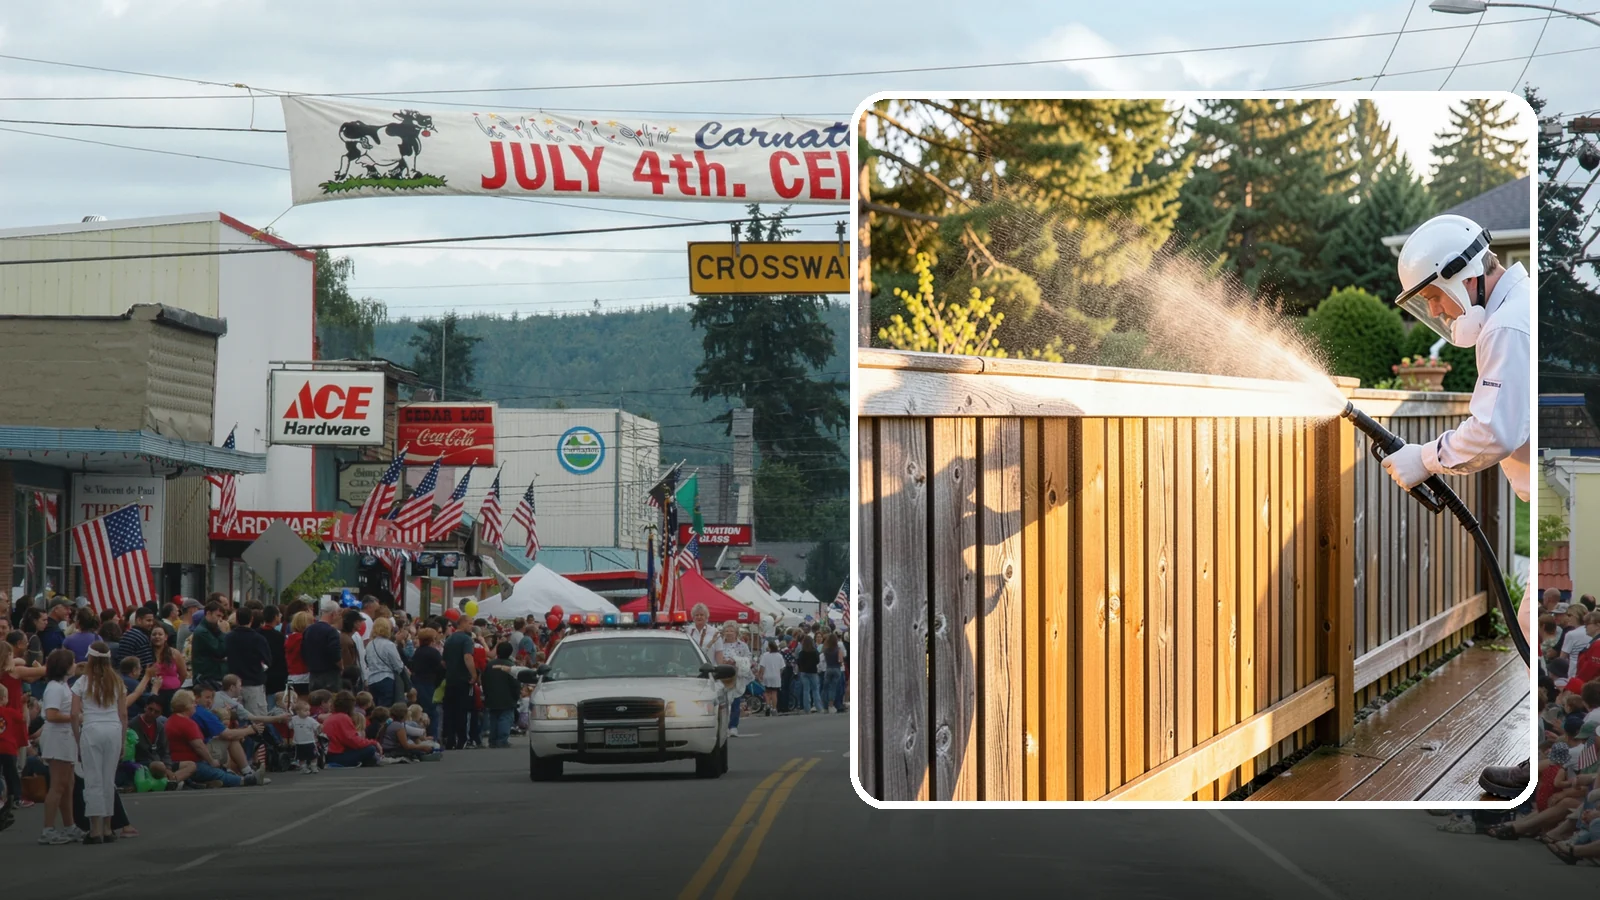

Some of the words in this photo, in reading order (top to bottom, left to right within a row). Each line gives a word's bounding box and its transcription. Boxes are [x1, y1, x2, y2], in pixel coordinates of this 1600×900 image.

[481, 141, 605, 192] JULY
[632, 150, 746, 197] 4th.
[697, 254, 850, 280] CROSSWA
[282, 380, 374, 420] ACE
[406, 410, 452, 422] CEDAR
[283, 421, 371, 437] Hardware
[417, 428, 477, 447] Coca-Cola
[353, 467, 384, 480] Simpl
[83, 485, 93, 494] St.
[95, 485, 124, 495] Vincent
[126, 486, 136, 495] de
[138, 486, 155, 495] Paul
[81, 503, 154, 522] THT
[688, 526, 742, 535] CRNATION
[698, 535, 730, 543] GLASS
